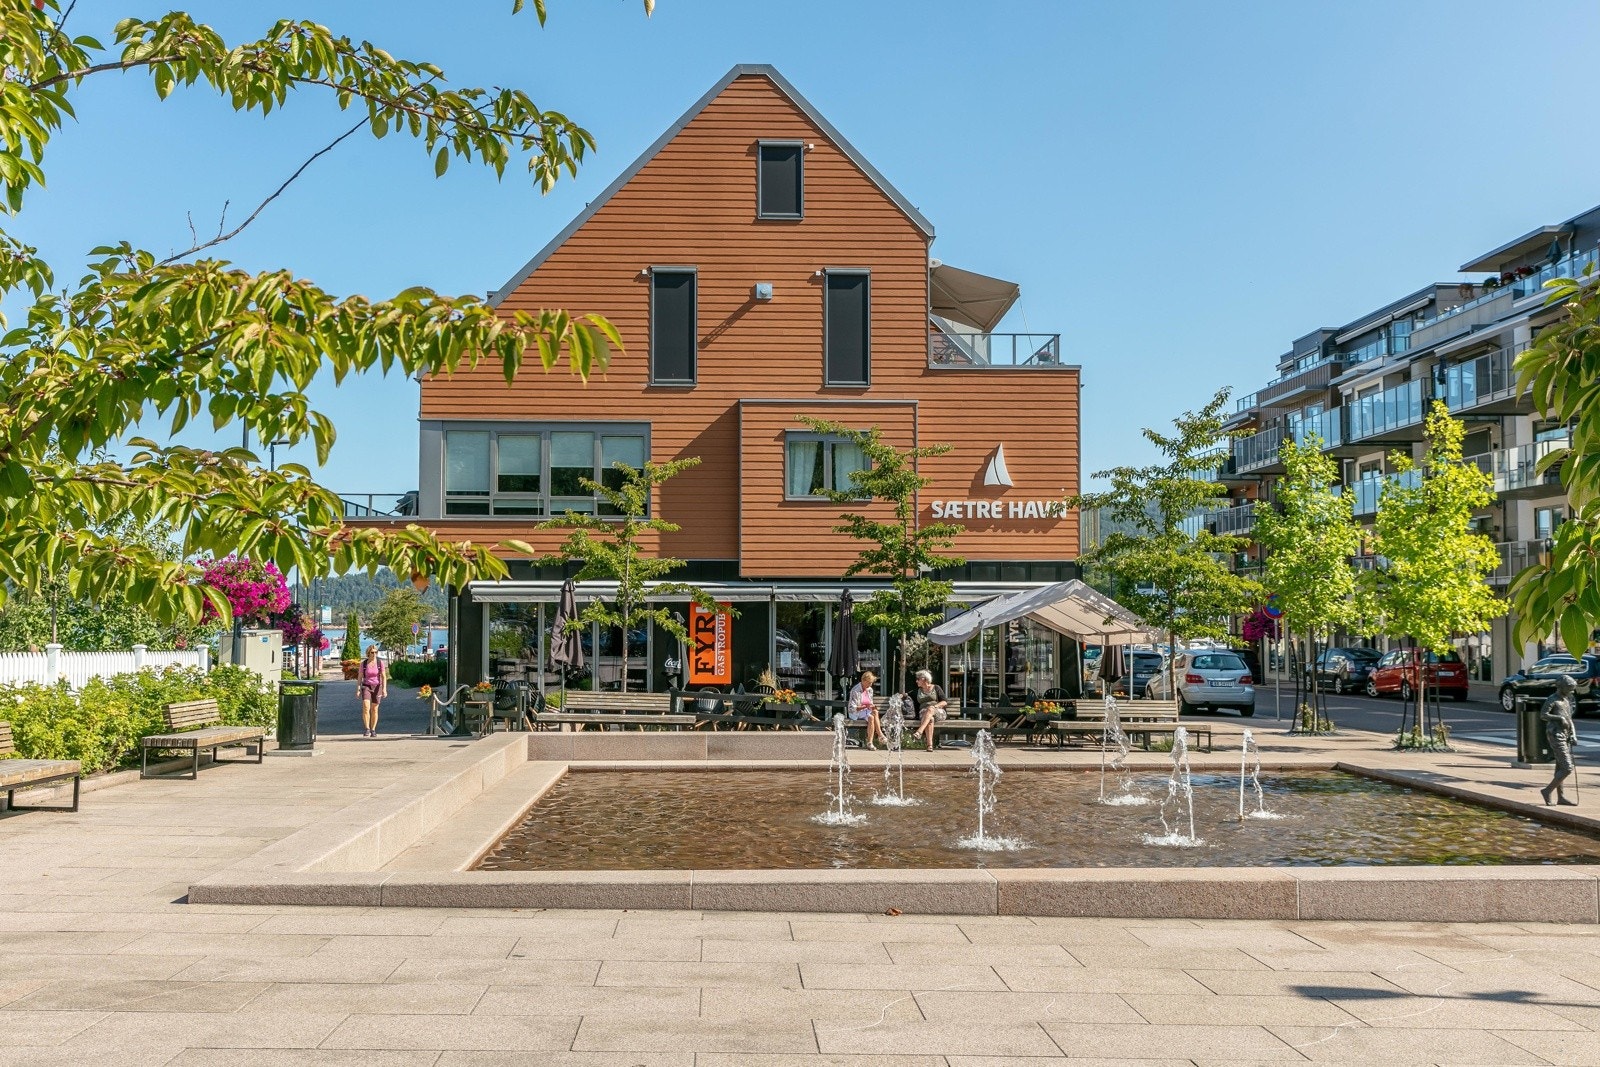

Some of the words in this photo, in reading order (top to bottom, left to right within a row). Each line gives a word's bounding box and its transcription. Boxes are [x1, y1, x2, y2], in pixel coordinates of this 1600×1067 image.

[931, 500, 1003, 519] SÆTRE
[695, 615, 715, 675] FYR
[717, 613, 726, 676] GASTROPUB
[1009, 619, 1020, 643] FYR
